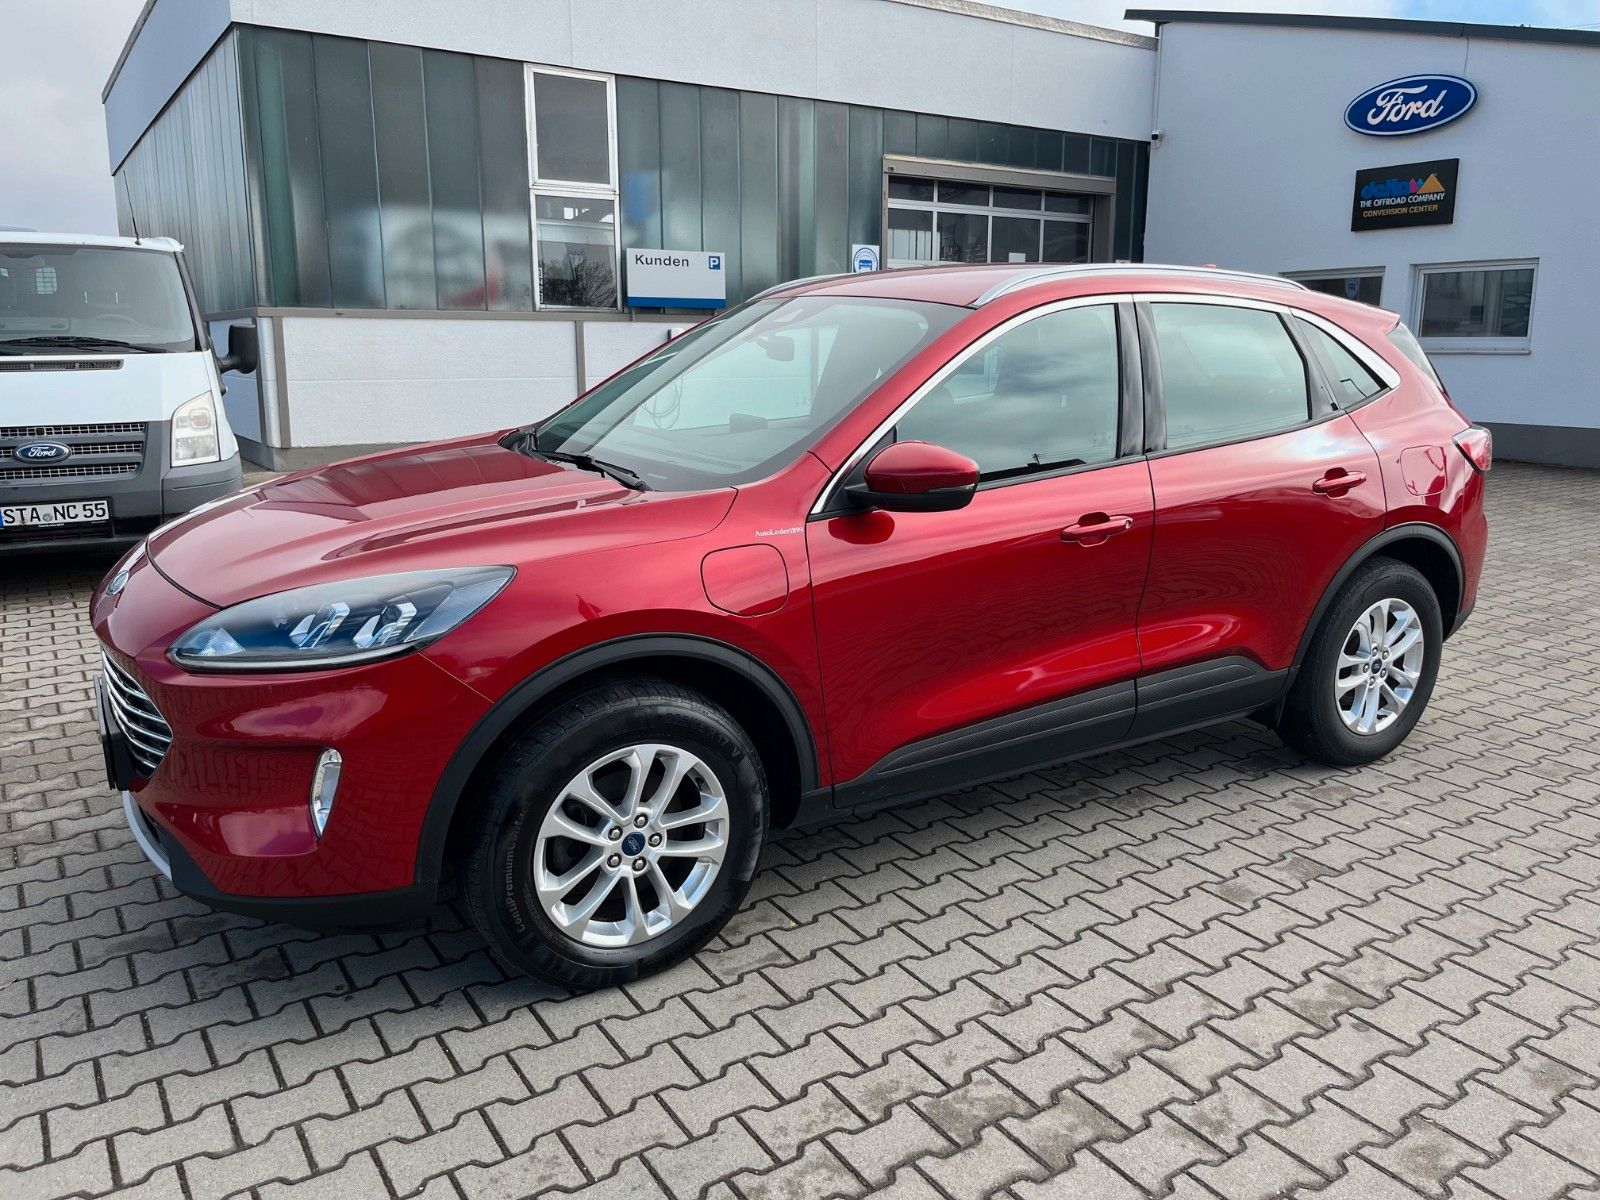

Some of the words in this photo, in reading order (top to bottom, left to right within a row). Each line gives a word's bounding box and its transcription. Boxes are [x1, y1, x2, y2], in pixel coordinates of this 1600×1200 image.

[1366, 84, 1448, 126] Ford
[1360, 199, 1372, 208] THE
[1373, 196, 1407, 207] OFFROAD
[1407, 192, 1446, 204] COMPANY
[1362, 207, 1408, 218] CONVERSION
[1409, 204, 1439, 213] CENTER
[635, 254, 689, 267] Kunden
[710, 257, 719, 268] P
[28, 446, 57, 458] Ford
[3, 507, 42, 524] STA
[53, 504, 78, 521] NC
[83, 502, 106, 519] 55
[503, 806, 529, 933] ContiPremiumC
